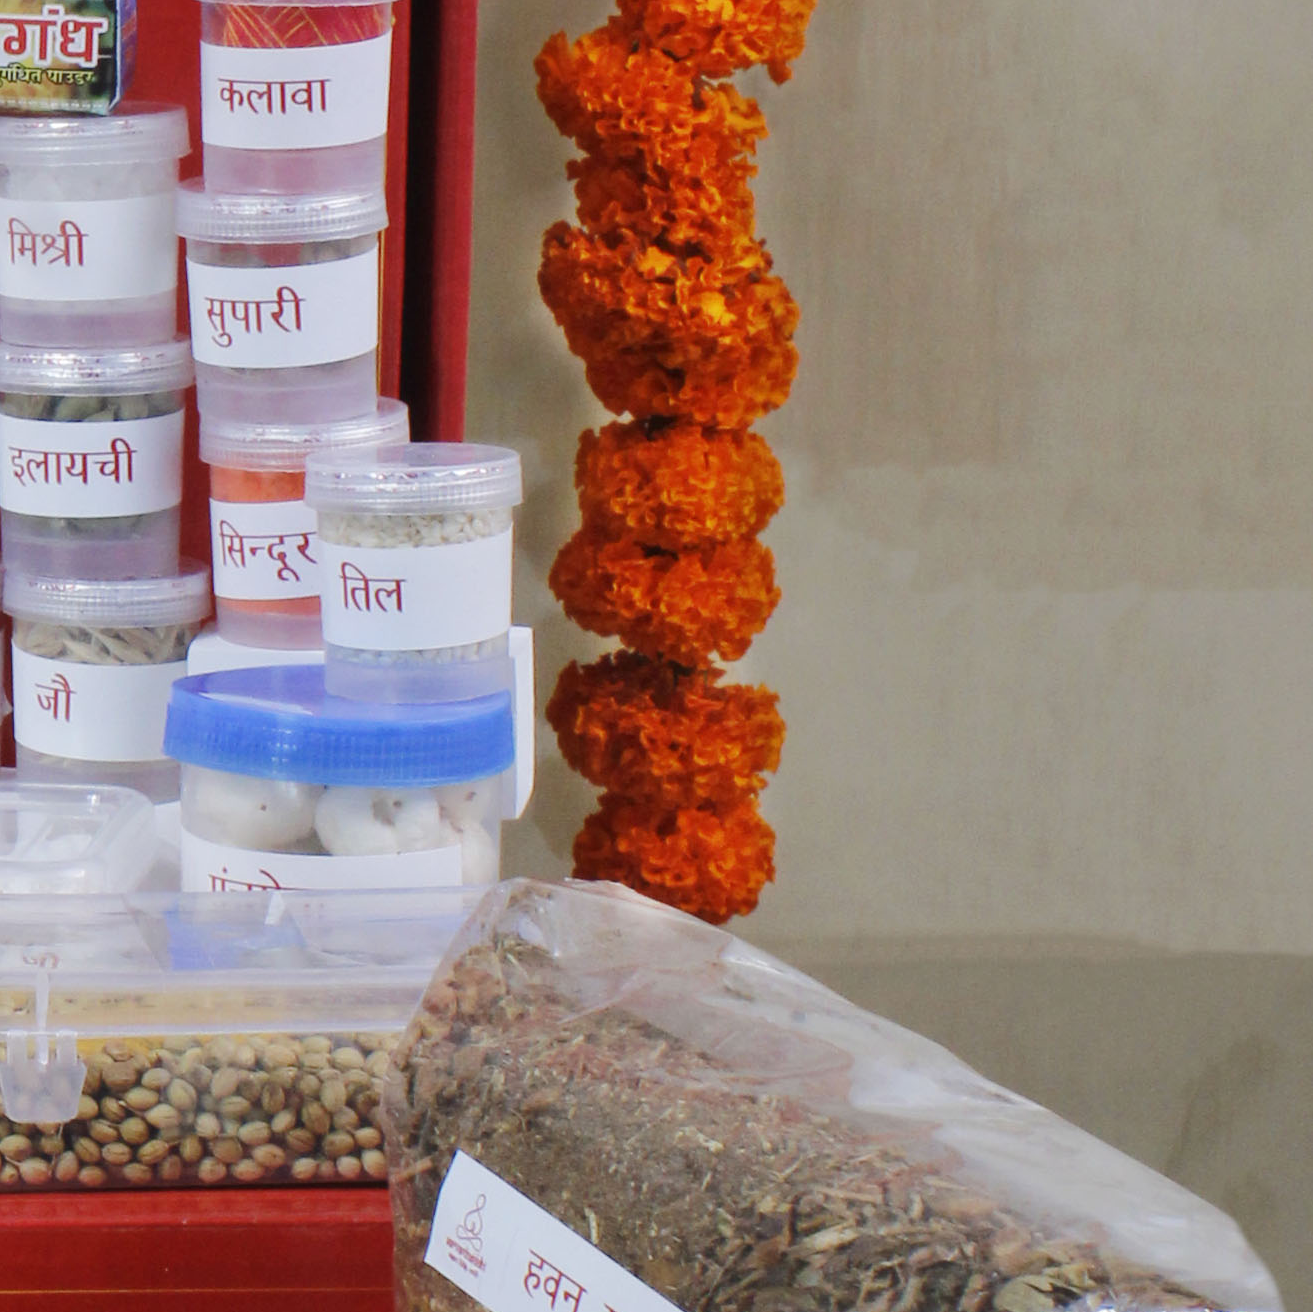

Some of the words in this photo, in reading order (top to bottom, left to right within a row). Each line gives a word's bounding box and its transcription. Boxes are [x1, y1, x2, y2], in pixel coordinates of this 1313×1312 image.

[217, 77, 331, 115] कलावा
[6, 217, 89, 268] मिश्री
[204, 286, 306, 348] सुपारी
[8, 437, 138, 488] इलायची
[218, 519, 318, 582] सिन्दूर
[338, 561, 408, 614] तिल
[34, 673, 77, 722] जौ
